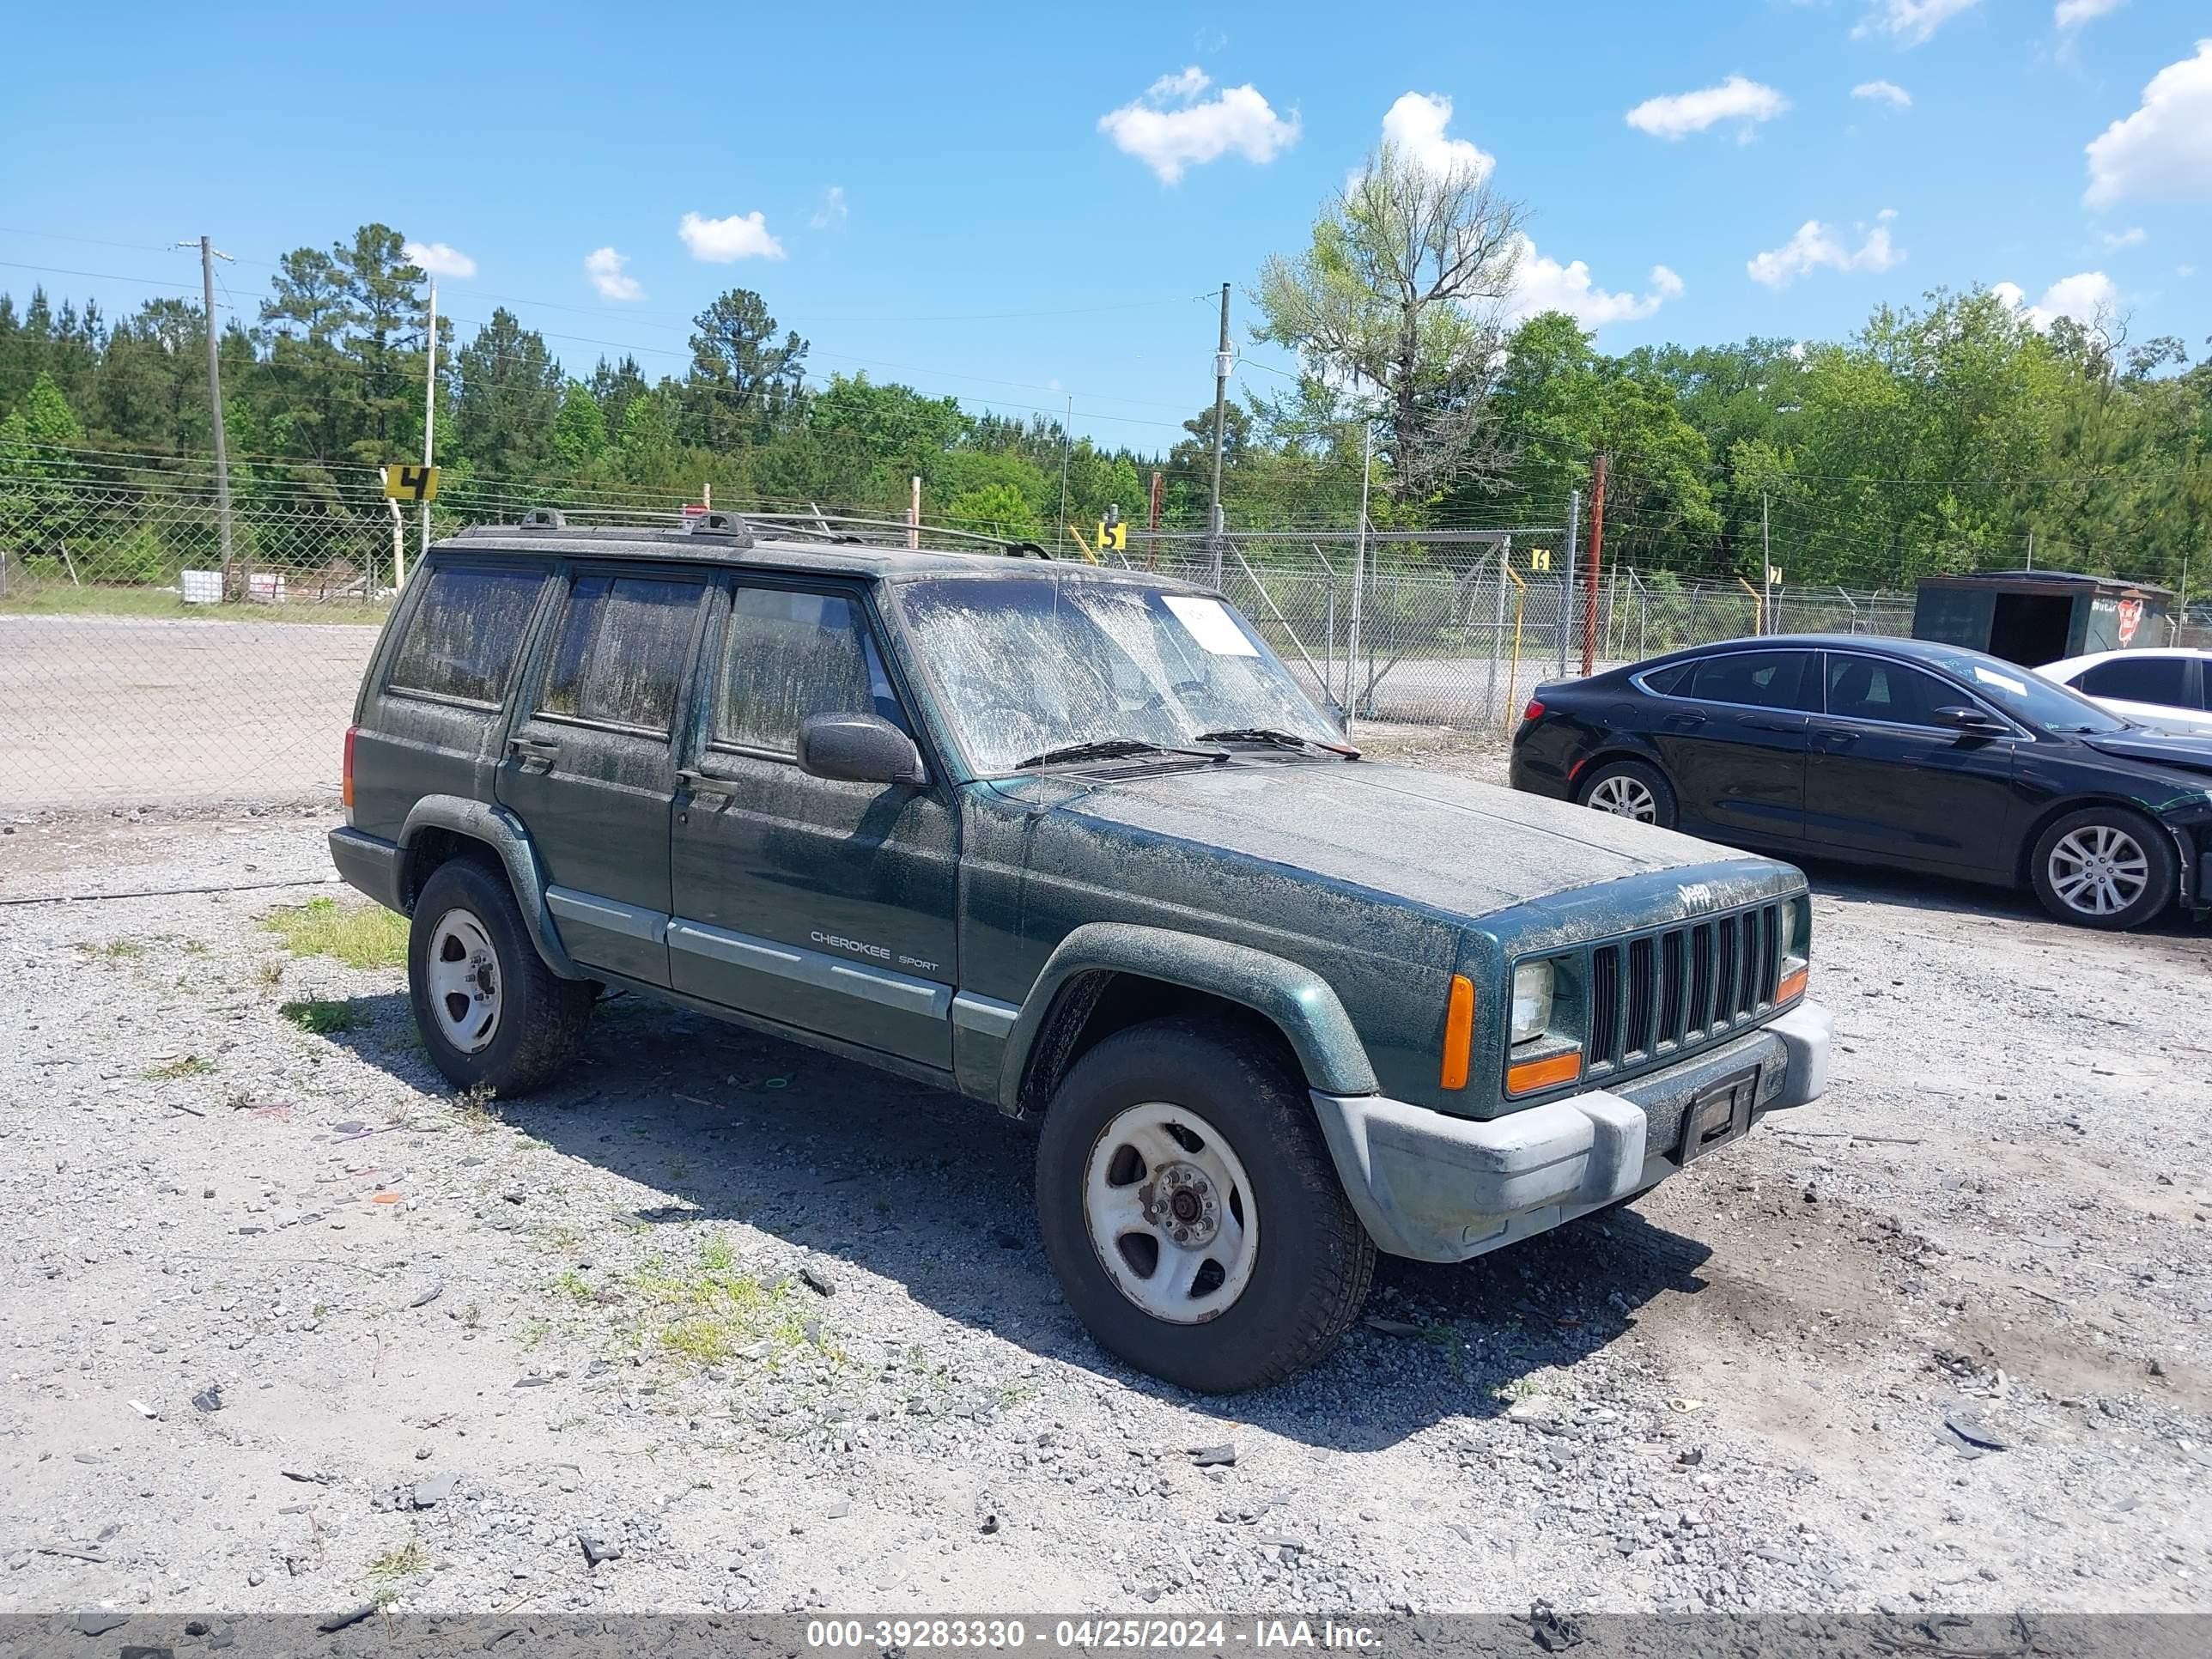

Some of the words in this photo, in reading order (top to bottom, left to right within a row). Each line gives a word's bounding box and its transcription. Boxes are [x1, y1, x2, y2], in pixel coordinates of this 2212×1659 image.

[401, 467, 429, 500] 4
[1102, 522, 1118, 549] 5
[1537, 550, 1547, 568] 6
[1772, 567, 1780, 584] 7
[1677, 884, 1711, 907] Jeep
[811, 931, 890, 960] CHEROKEE
[898, 955, 939, 972] SPORT
